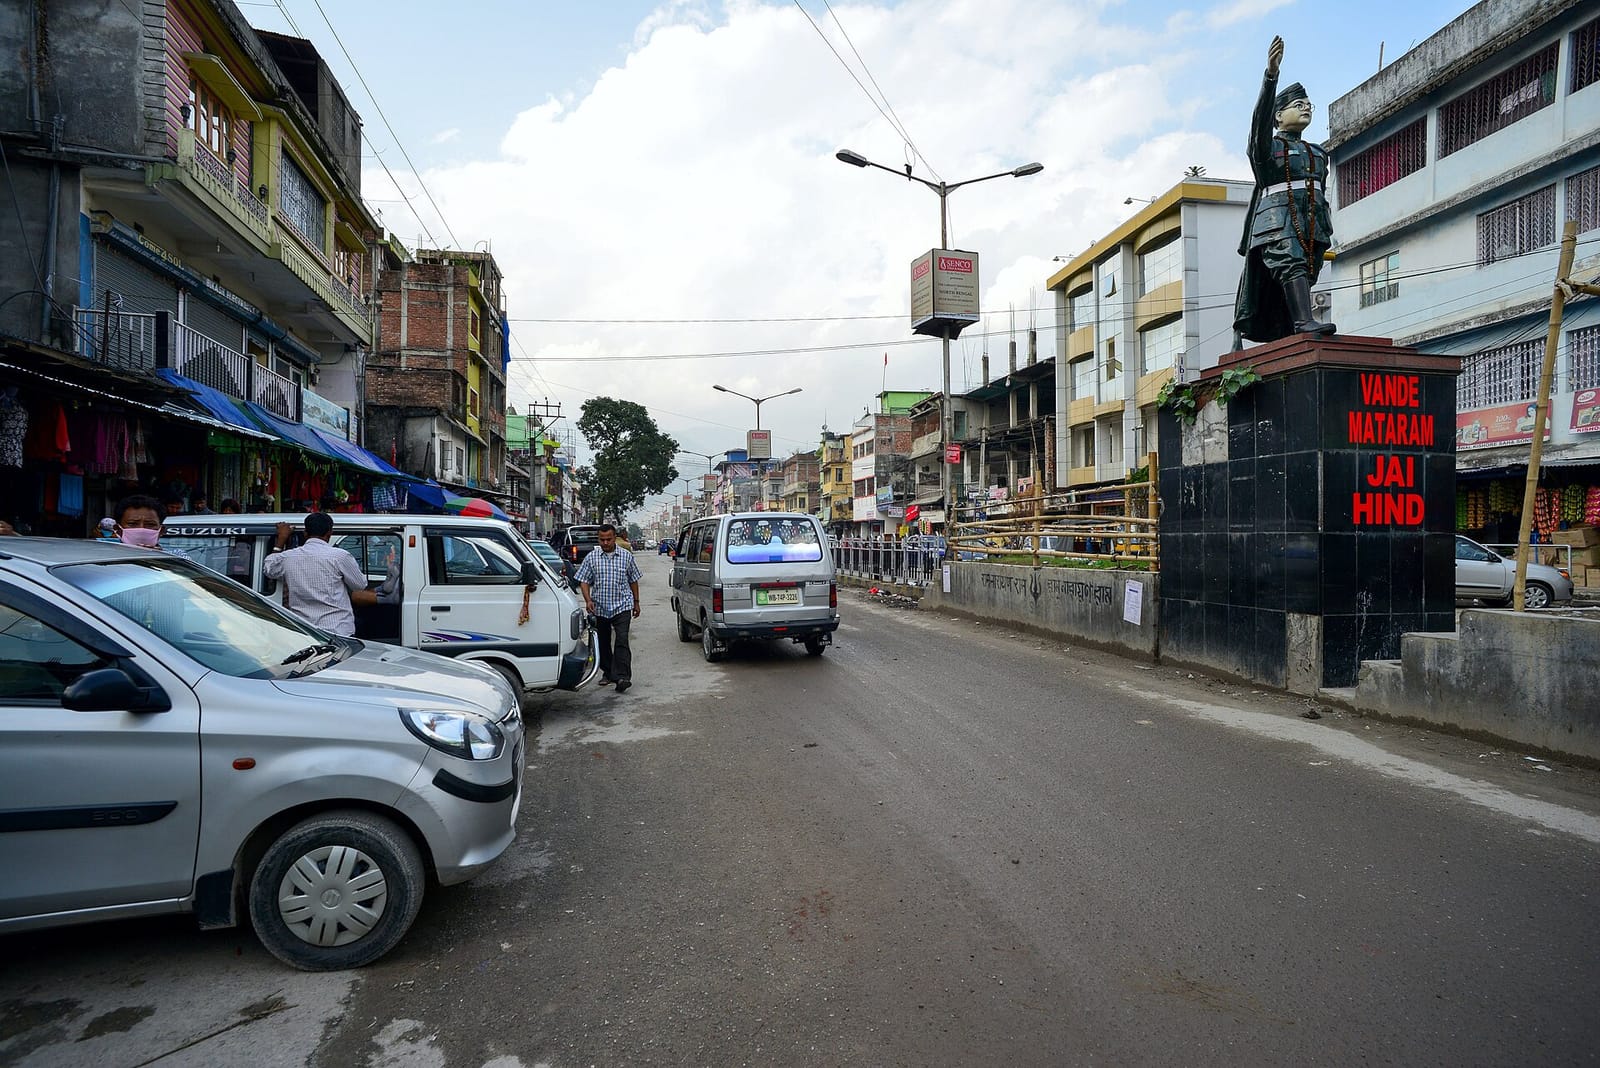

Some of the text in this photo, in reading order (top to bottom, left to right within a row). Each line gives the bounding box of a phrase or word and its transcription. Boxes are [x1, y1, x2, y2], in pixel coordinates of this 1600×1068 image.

[946, 260, 971, 268] SENCO
[1361, 374, 1419, 408] VANDE
[1348, 411, 1434, 446] MATARAM
[1367, 455, 1414, 488] JAI
[1353, 493, 1425, 525] HIND
[166, 527, 247, 536] SUZUKI
